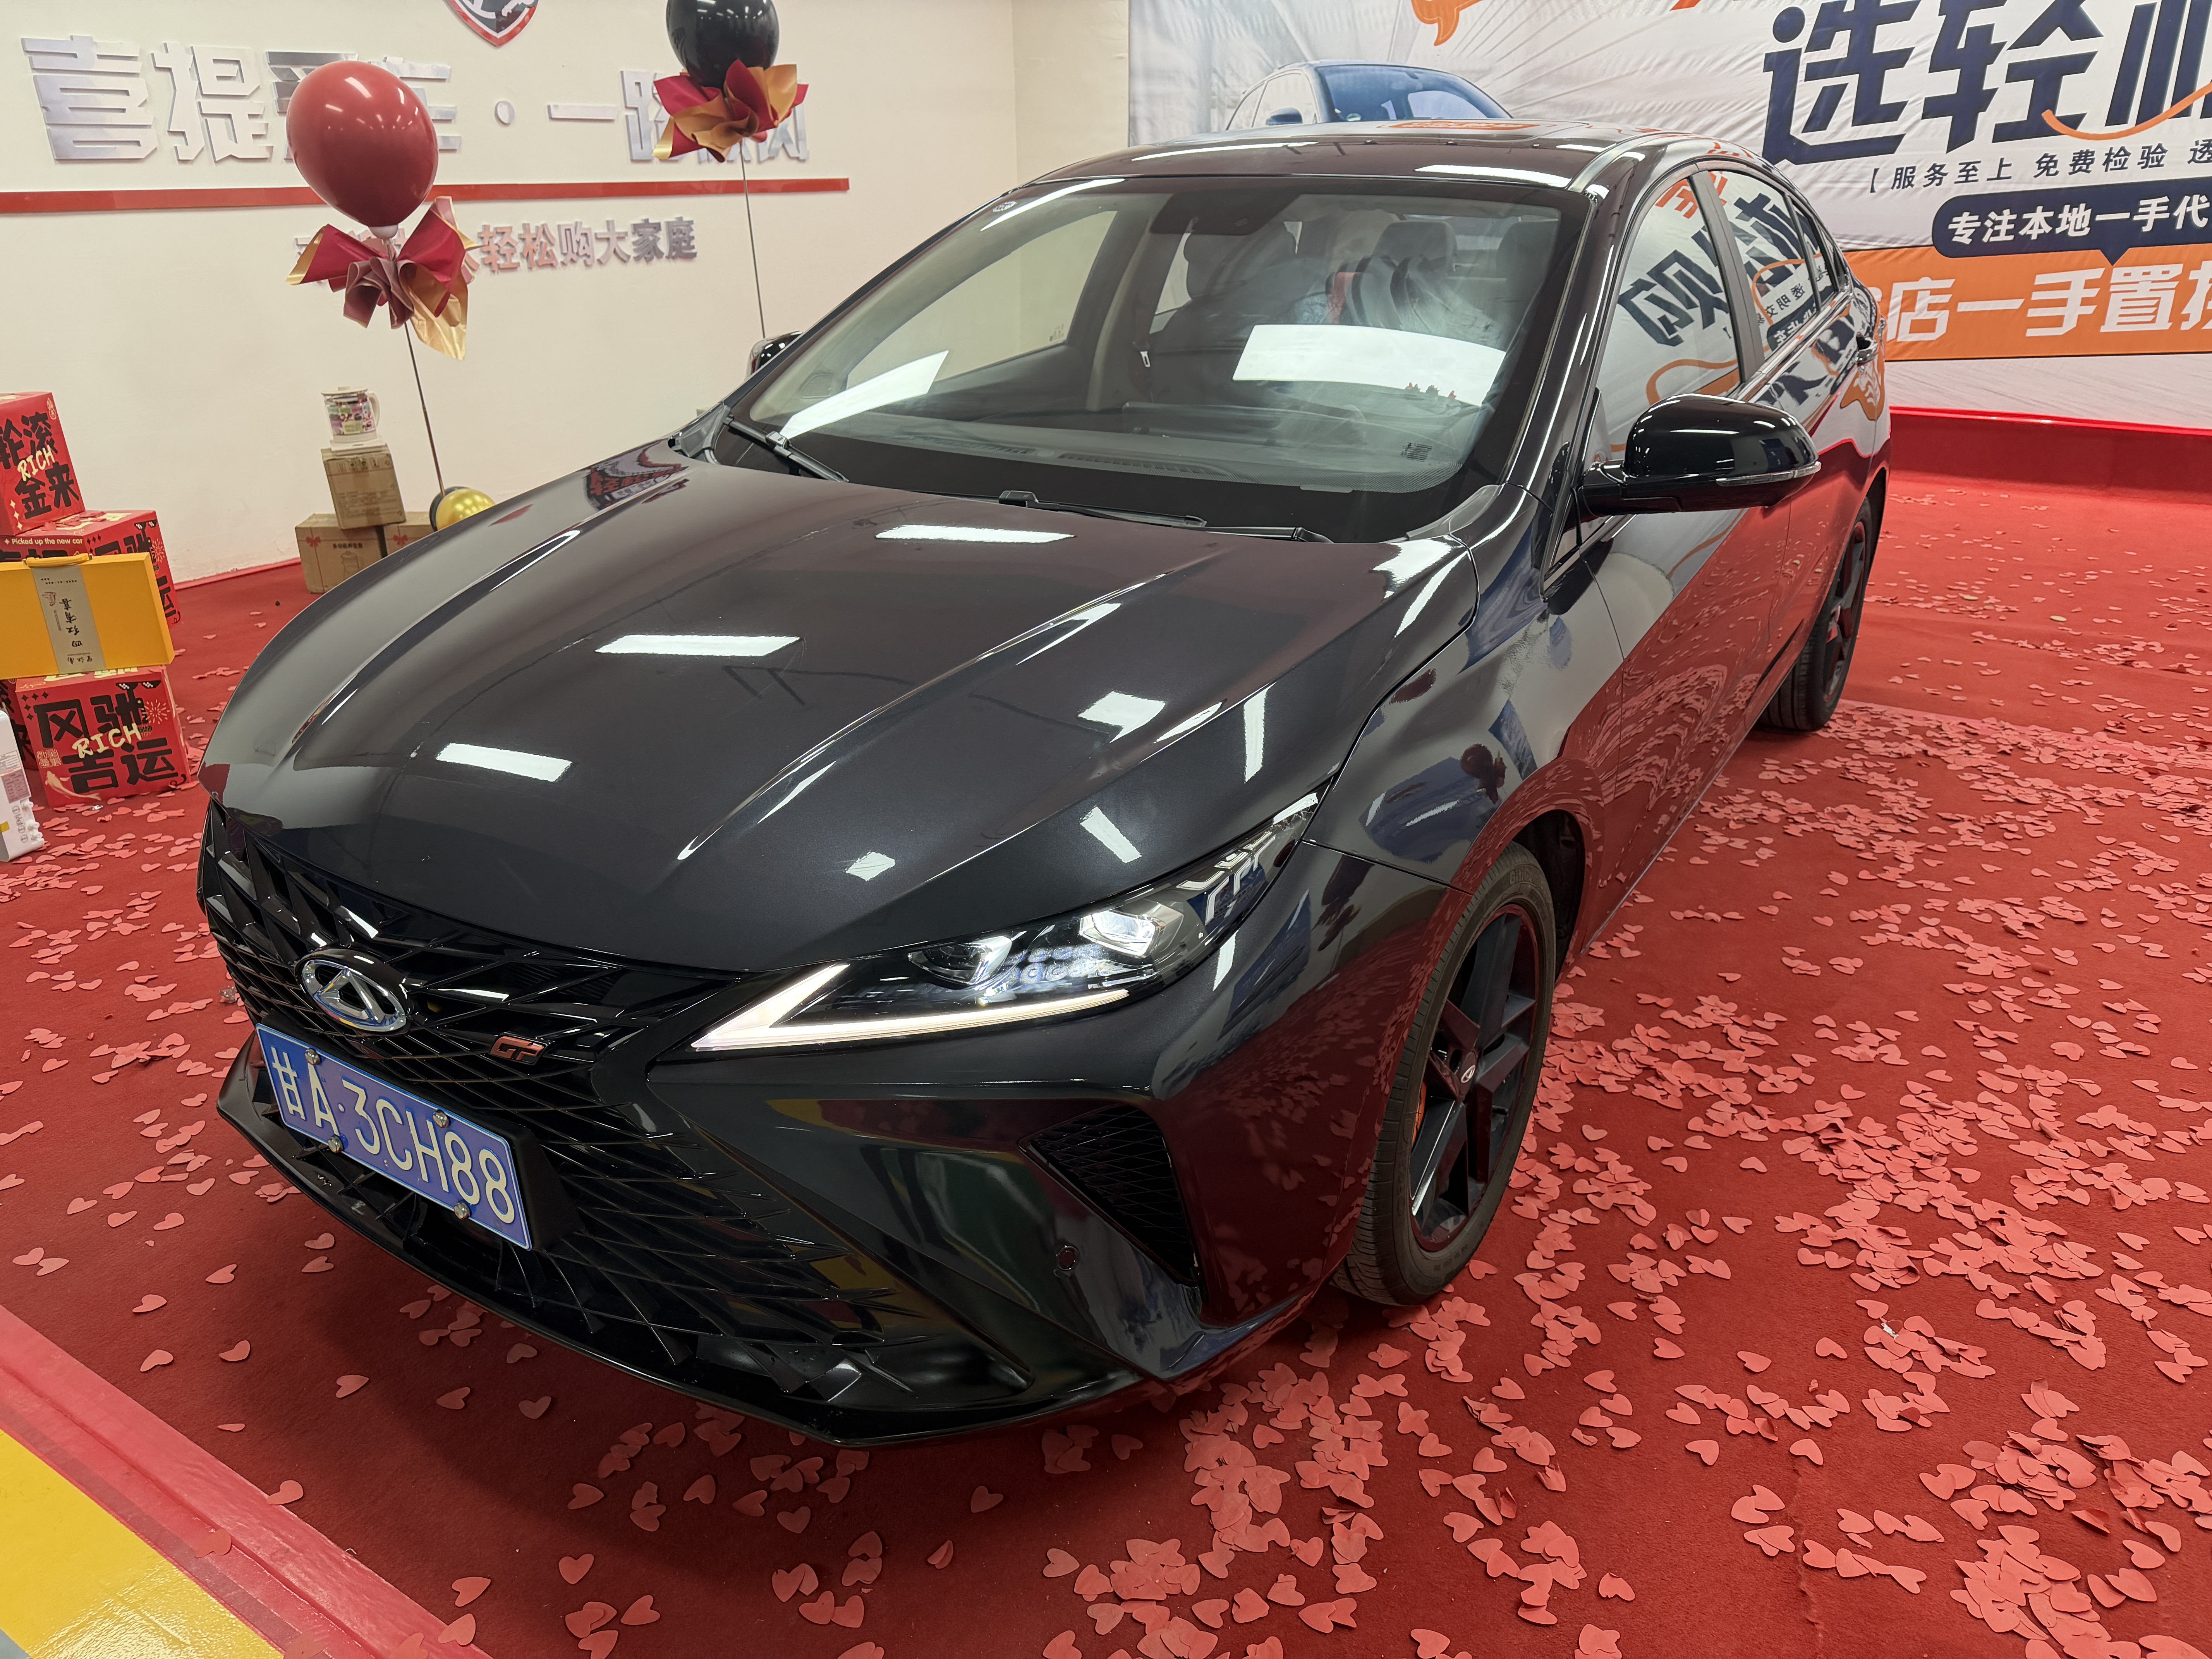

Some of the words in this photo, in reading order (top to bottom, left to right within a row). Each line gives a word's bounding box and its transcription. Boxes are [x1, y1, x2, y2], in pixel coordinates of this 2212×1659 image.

[2033, 143, 2168, 178] 免费检验
[1948, 194, 2210, 245] 专注本地一手代
[1868, 260, 2212, 342] 店一手置
[17, 445, 55, 481] RICH
[15, 462, 80, 520] 金来
[33, 688, 149, 748] 风驰
[72, 723, 142, 759] RICH
[61, 737, 179, 794] 吉运
